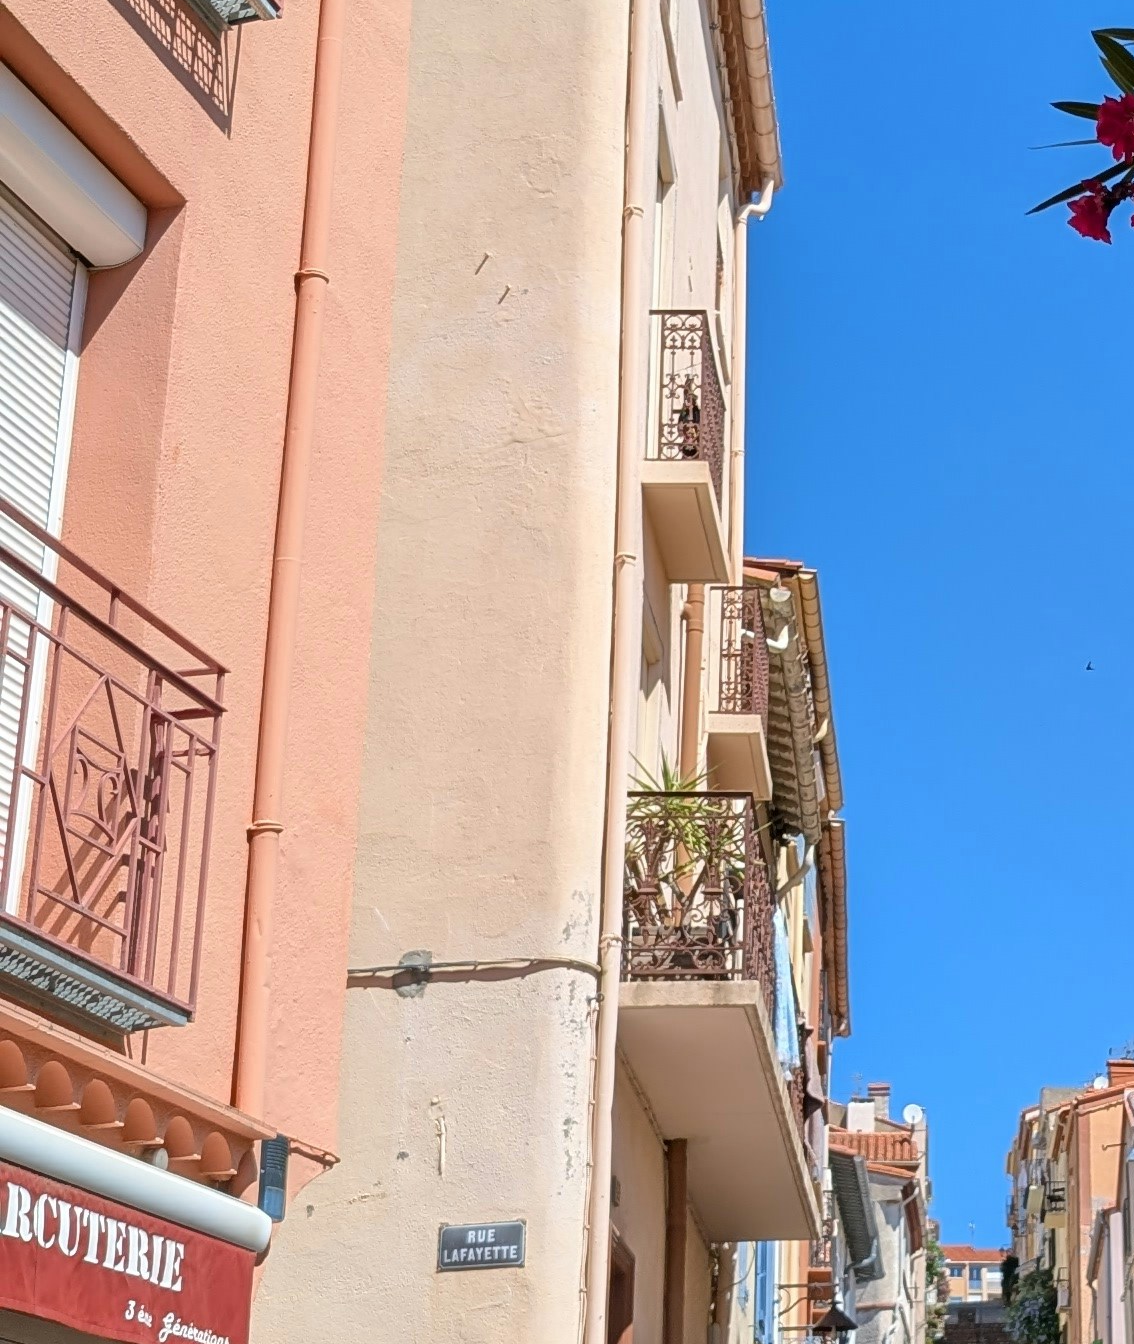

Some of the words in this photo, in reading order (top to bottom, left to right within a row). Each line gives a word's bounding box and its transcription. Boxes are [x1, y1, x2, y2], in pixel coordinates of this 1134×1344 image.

[0, 1182, 185, 1292] RCUTERIE
[467, 1229, 496, 1244] RUE
[443, 1245, 518, 1263] LAFAYETTE
[125, 1299, 136, 1320] 3
